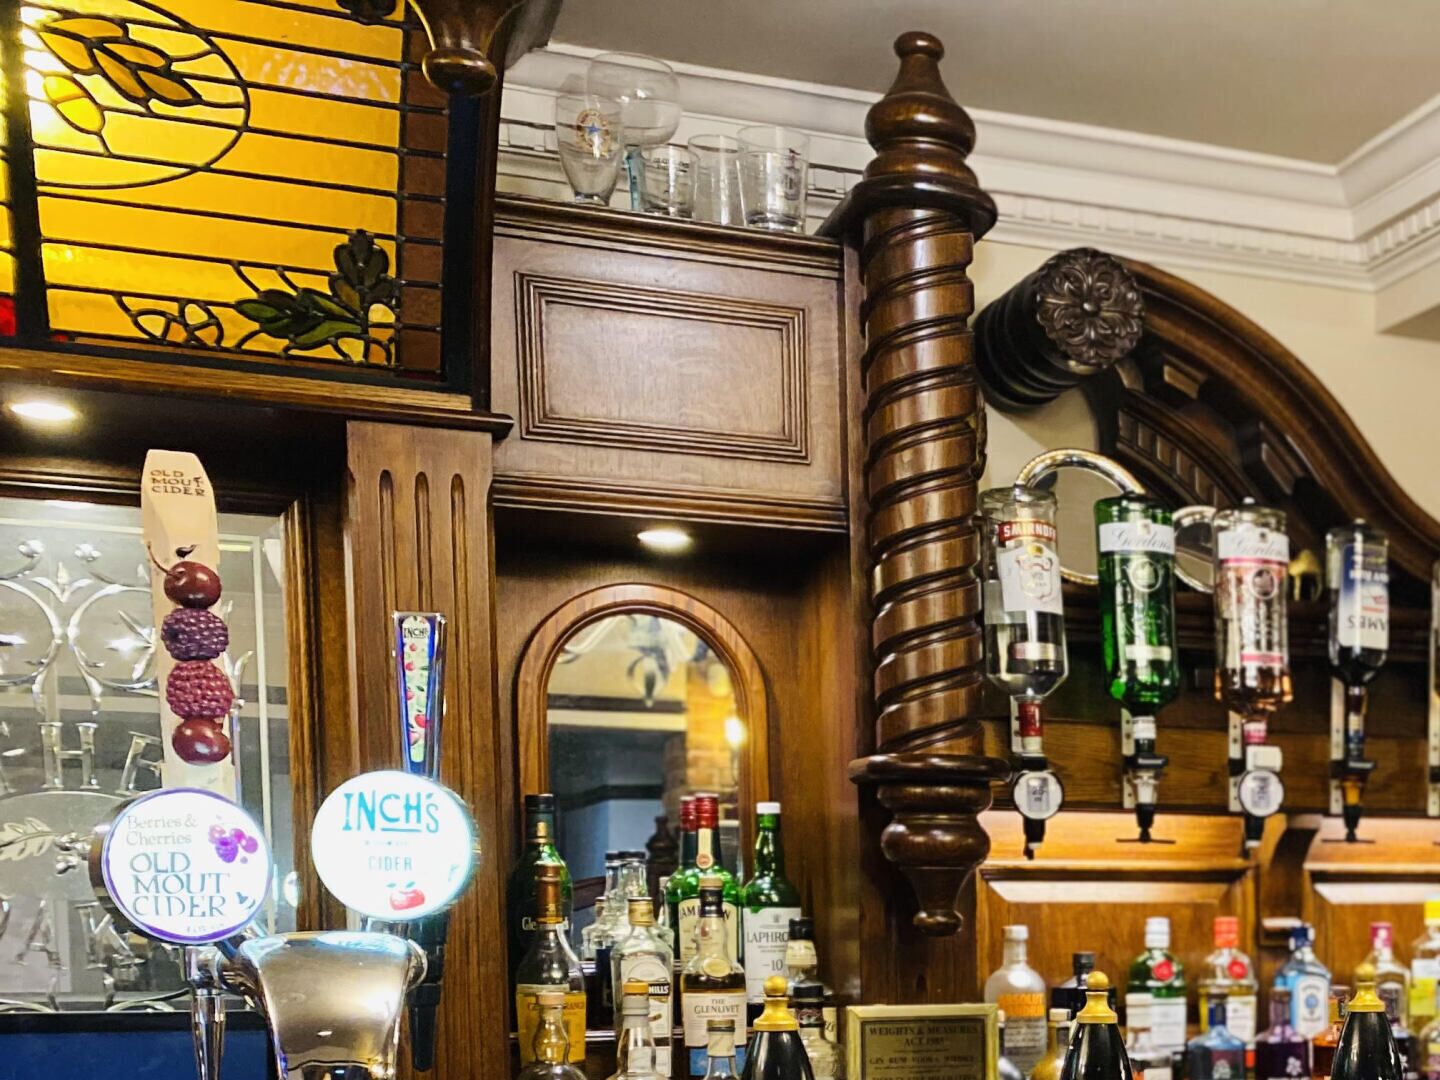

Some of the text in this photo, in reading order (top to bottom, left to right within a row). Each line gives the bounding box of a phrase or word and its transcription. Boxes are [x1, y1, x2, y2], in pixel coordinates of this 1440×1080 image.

[150, 469, 184, 478] OLD
[151, 476, 204, 488] MOUT
[151, 485, 206, 497] CIDER
[342, 789, 440, 834] INCH'S
[127, 812, 198, 830] Berries &
[125, 830, 193, 847] Cherries
[129, 851, 191, 874] OLD
[368, 855, 413, 872] CIDER
[131, 872, 231, 895] MOUT
[132, 894, 227, 918] CIDER
[694, 1005, 740, 1015] GLENLIVET
[870, 1026, 915, 1036] WEIGHTS
